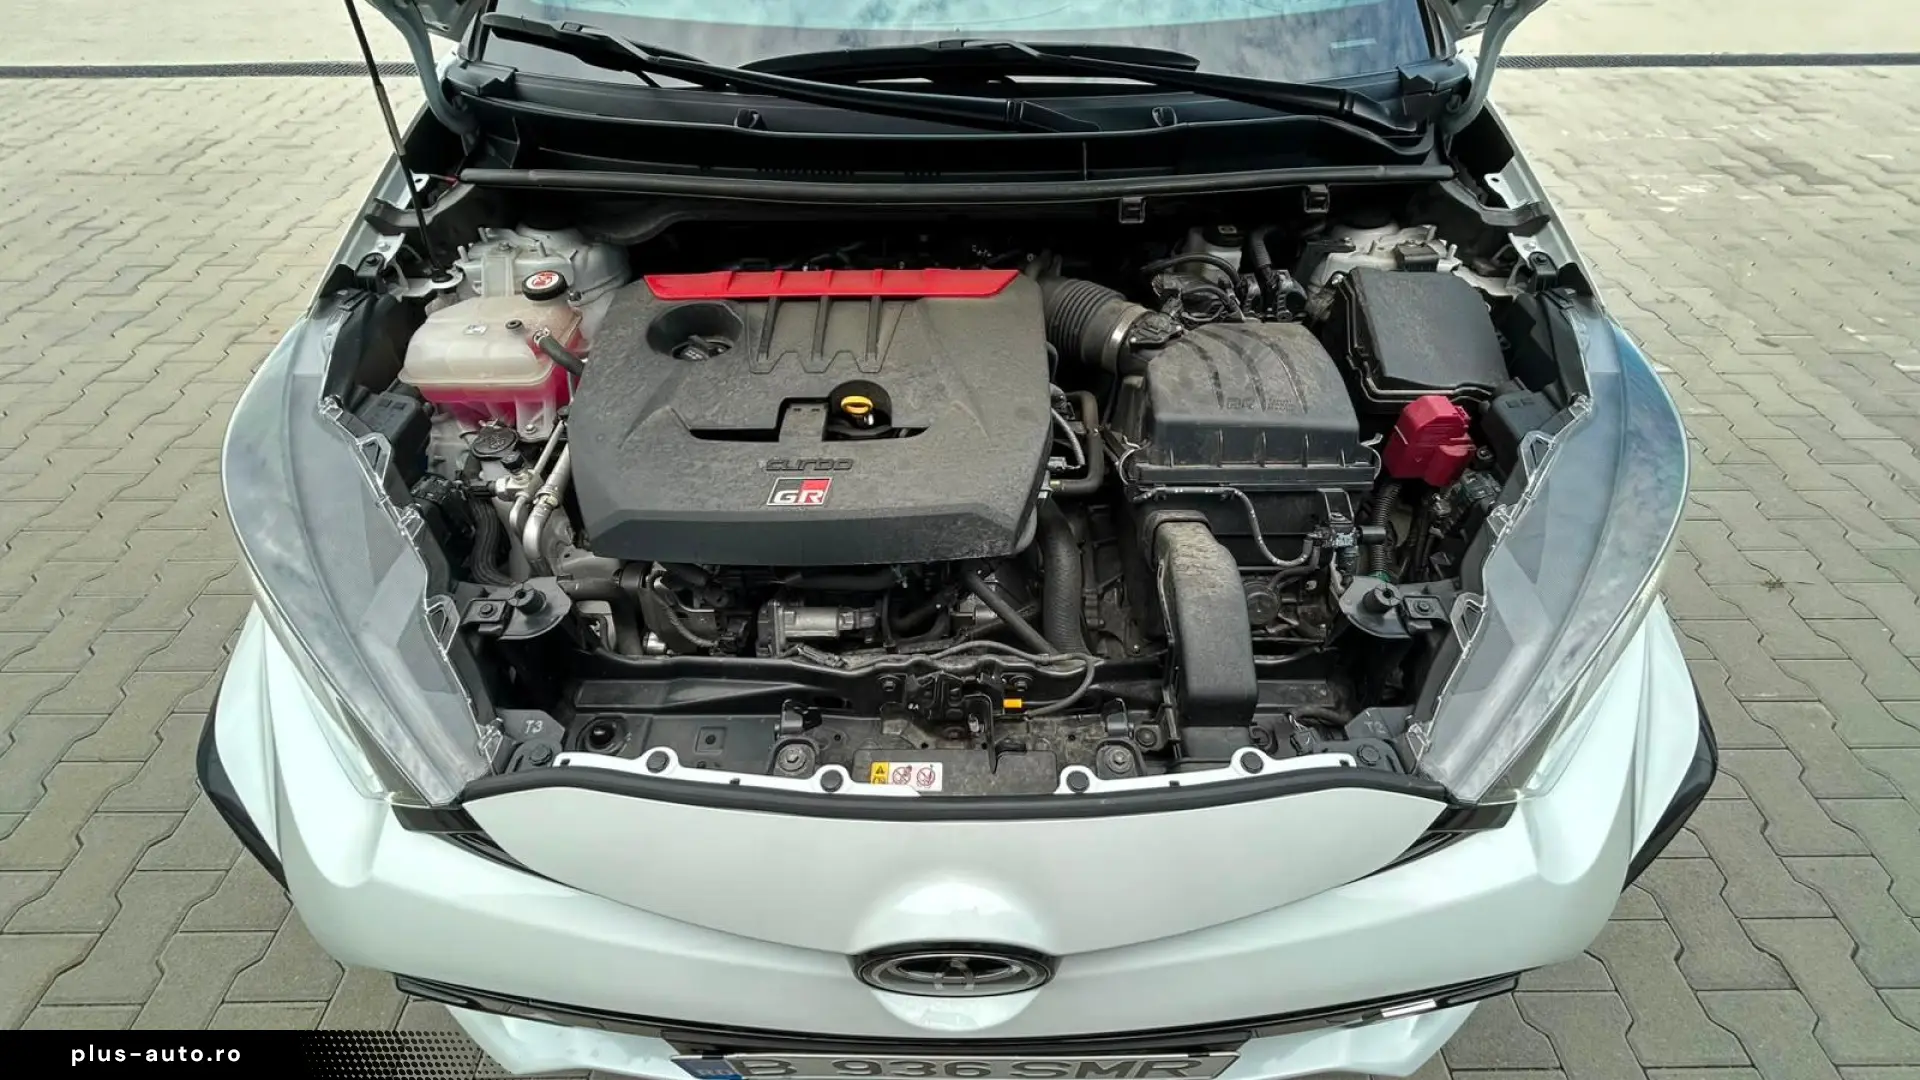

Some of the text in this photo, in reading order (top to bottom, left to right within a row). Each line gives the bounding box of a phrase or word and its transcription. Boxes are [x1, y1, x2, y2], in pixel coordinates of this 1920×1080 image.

[773, 489, 824, 504] GR
[737, 1059, 1202, 1078] B 936 SMR
